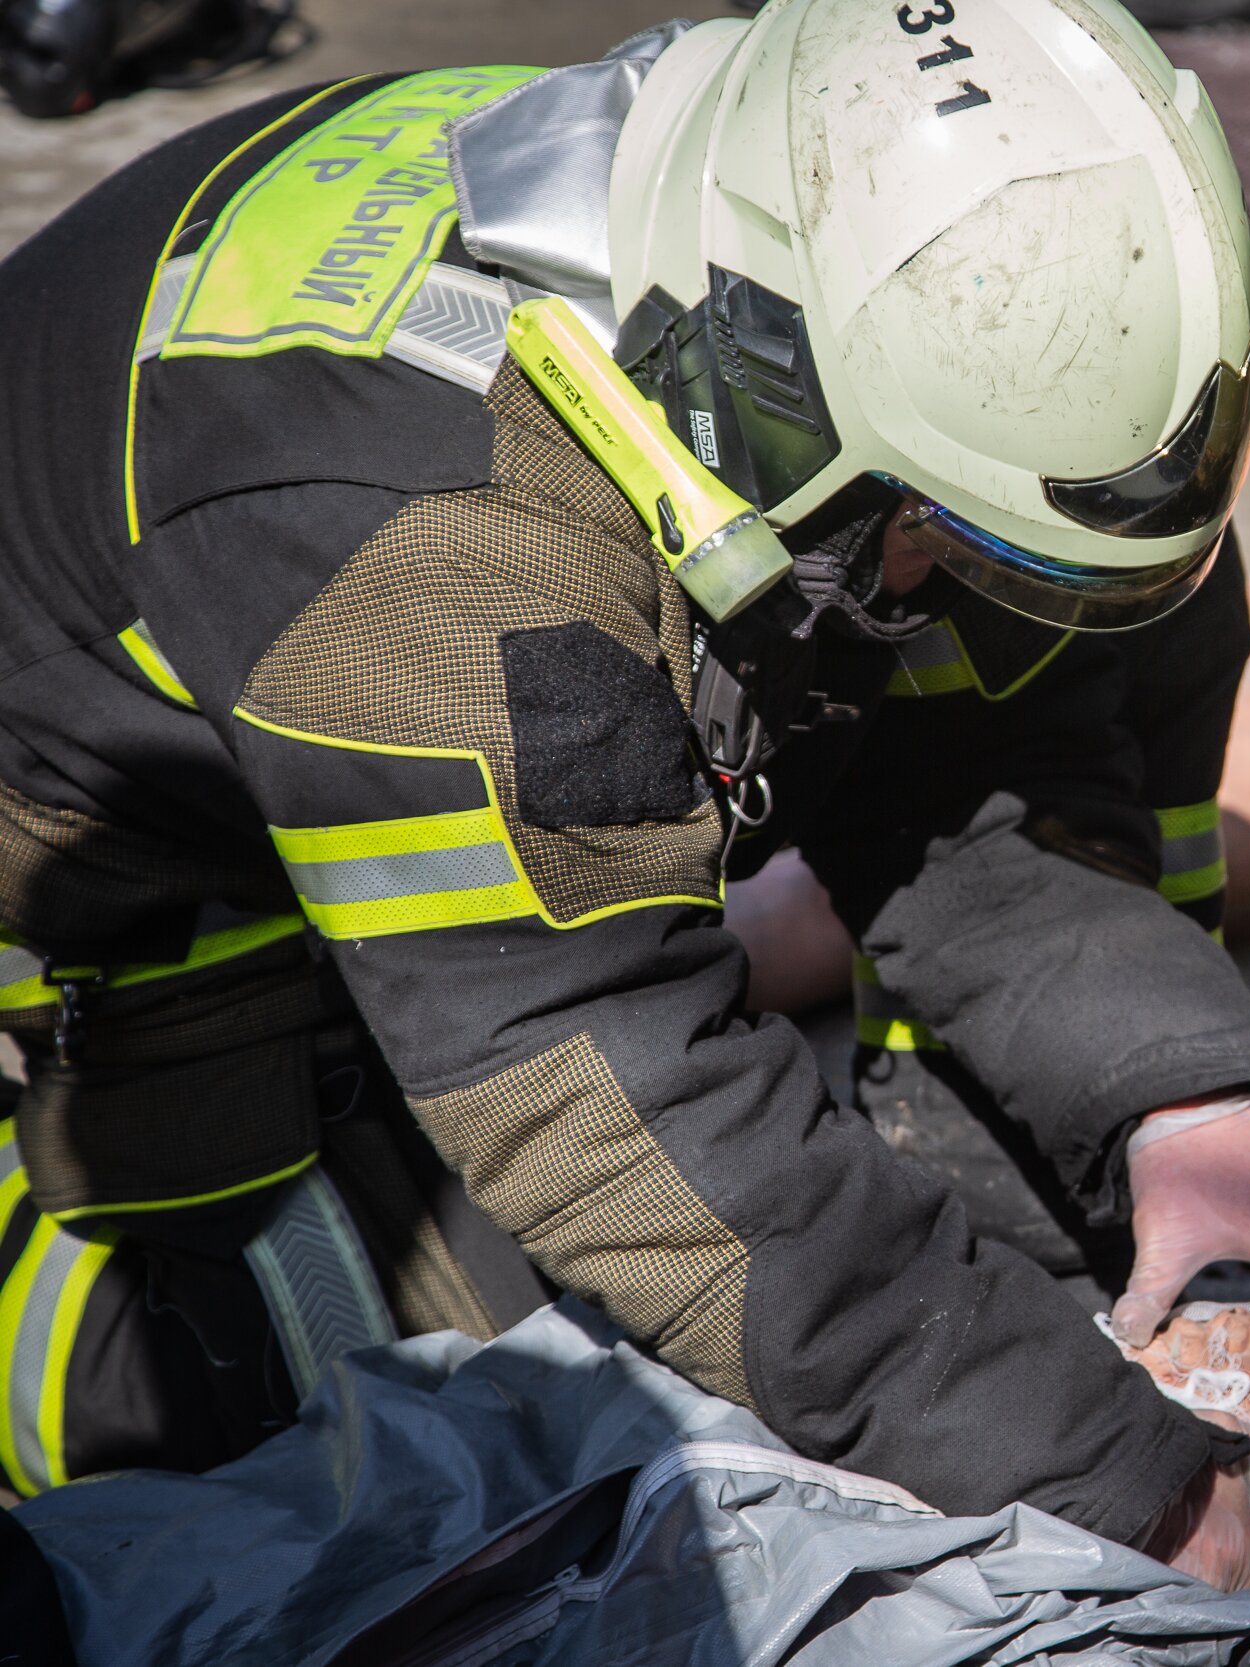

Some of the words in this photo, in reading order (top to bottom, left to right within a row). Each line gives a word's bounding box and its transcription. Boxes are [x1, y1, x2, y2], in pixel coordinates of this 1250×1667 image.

[897, 0, 992, 117] 311
[541, 355, 583, 407] MSA
[697, 413, 717, 462] MSA
